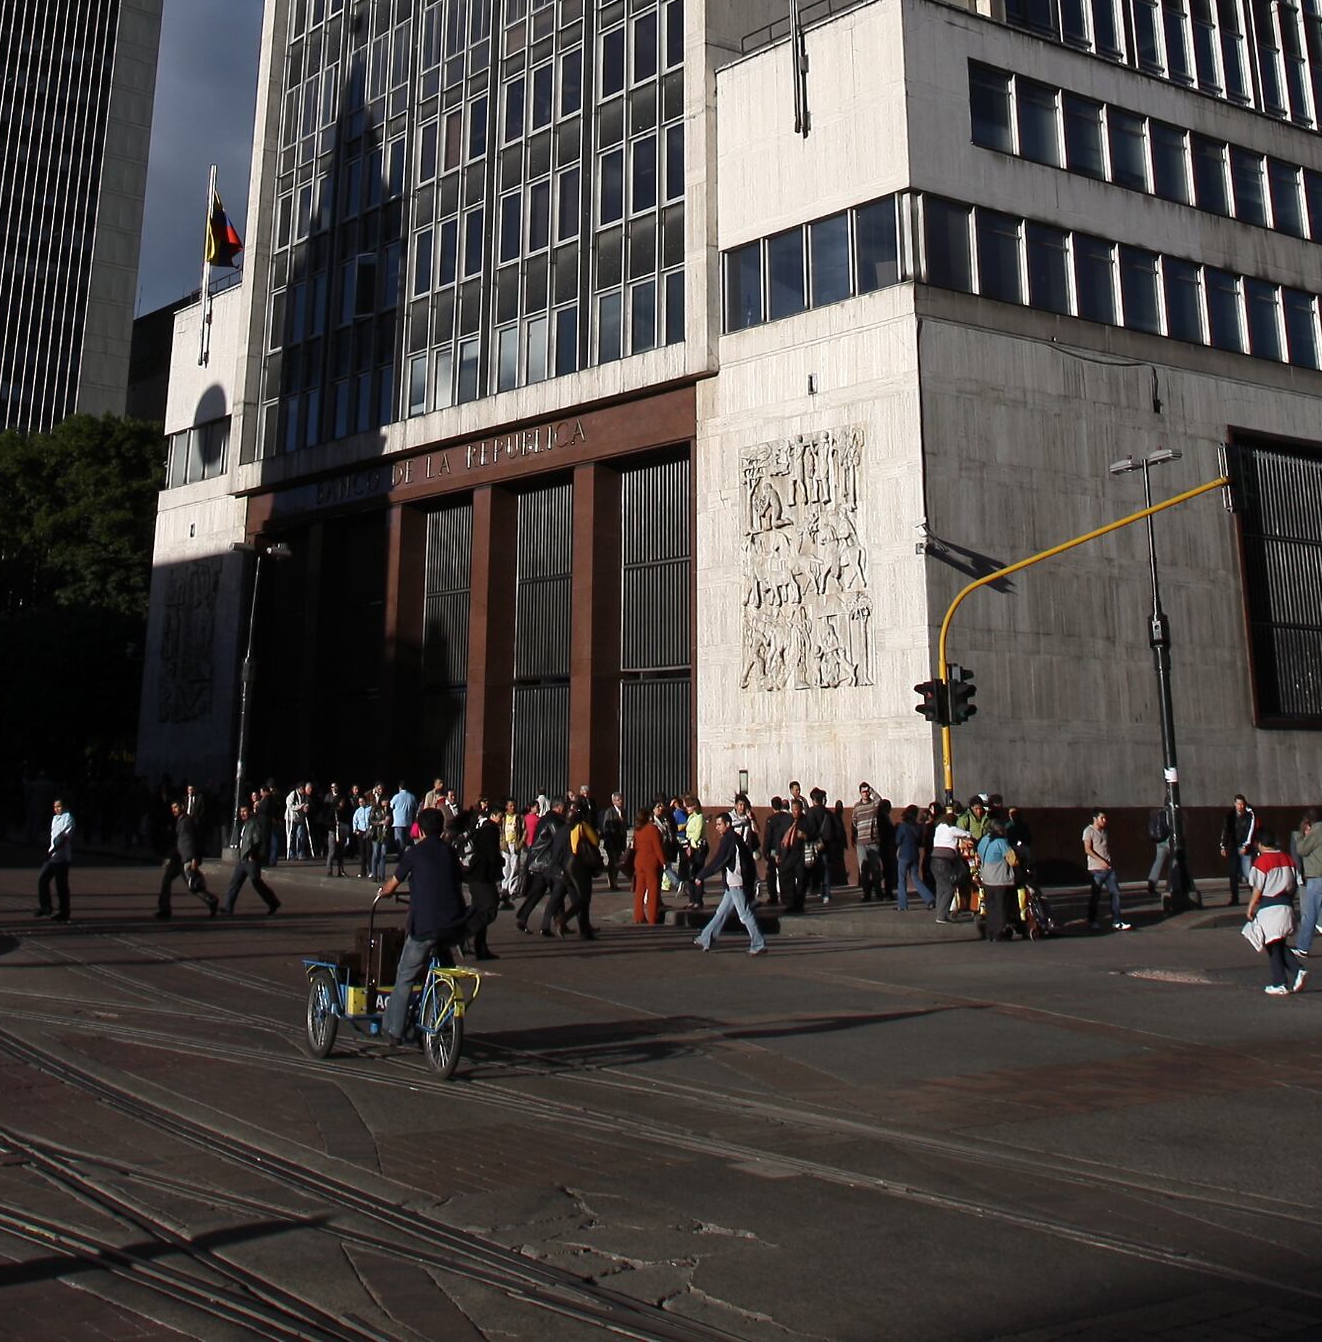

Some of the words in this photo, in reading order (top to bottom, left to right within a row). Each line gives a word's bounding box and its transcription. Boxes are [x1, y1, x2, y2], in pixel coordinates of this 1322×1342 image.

[390, 459, 415, 488] DE
[426, 453, 451, 479] LA
[465, 418, 587, 470] REPUBLICA
